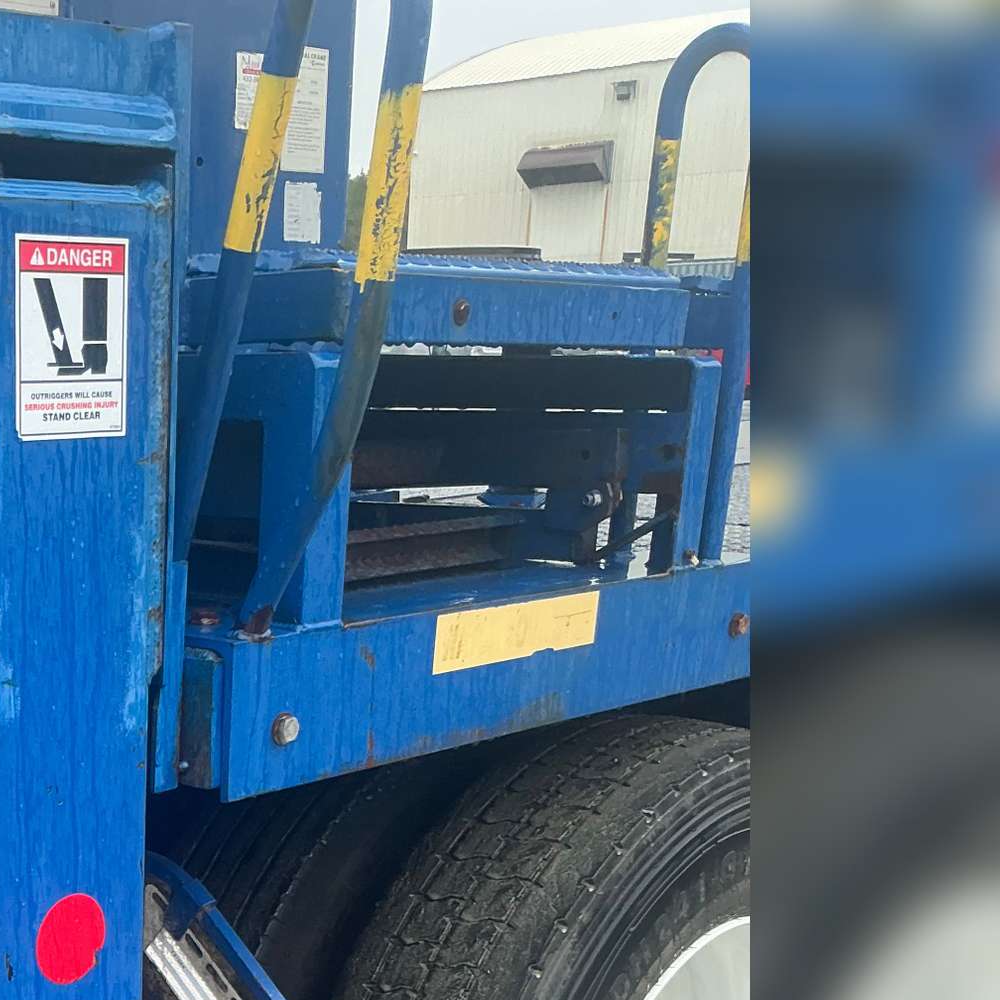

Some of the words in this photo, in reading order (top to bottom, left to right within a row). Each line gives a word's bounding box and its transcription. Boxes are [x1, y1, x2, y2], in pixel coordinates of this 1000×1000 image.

[46, 247, 113, 267] DANGER
[30, 392, 73, 400] OUTRIGGERS
[75, 391, 90, 399] WILL
[91, 390, 113, 398] CAUSE
[24, 402, 55, 411] SERIOUS
[56, 401, 92, 410] CRUSHING
[94, 400, 118, 409] INJURY
[42, 412, 71, 422] STAND
[73, 411, 101, 421] CLEAR
